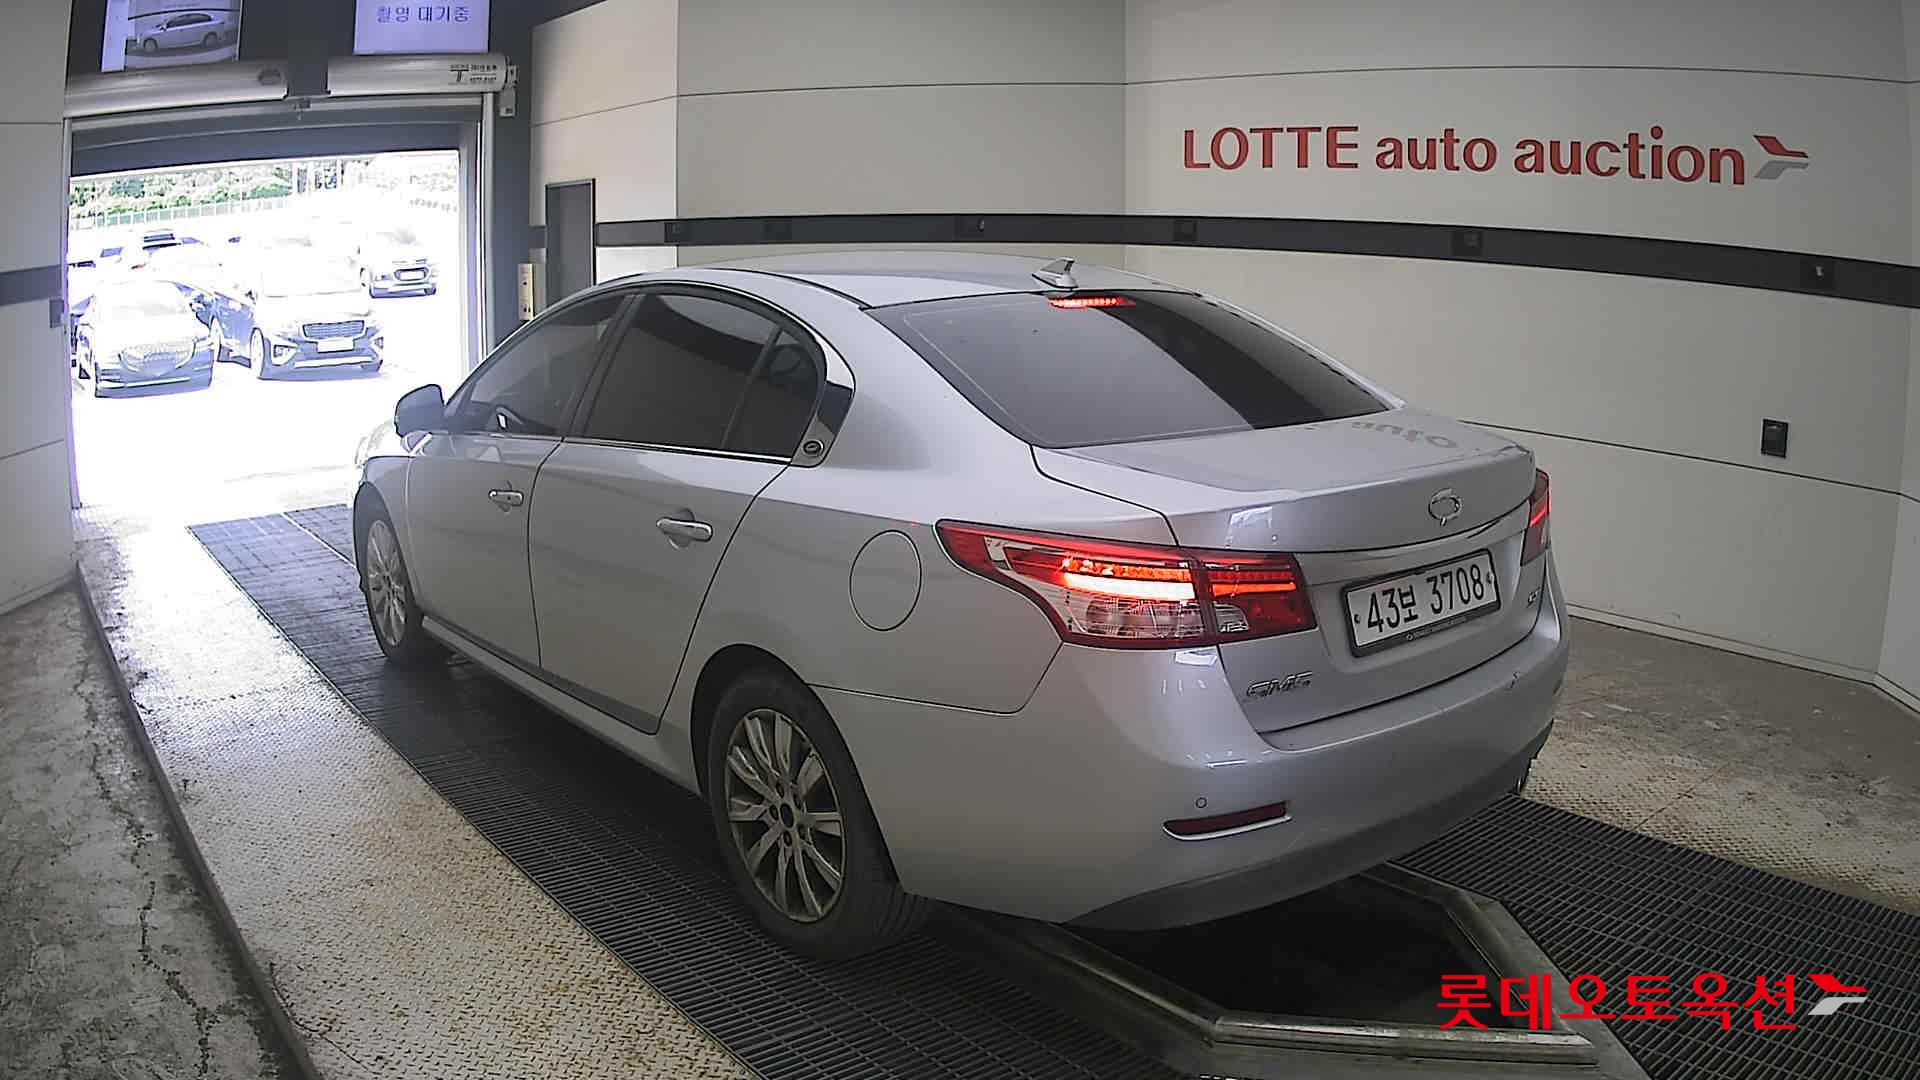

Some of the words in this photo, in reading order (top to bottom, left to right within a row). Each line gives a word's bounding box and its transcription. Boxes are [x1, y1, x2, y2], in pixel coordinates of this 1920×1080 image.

[418, 5, 469, 22] 대기중
[1184, 126, 1359, 169] LOTTE
[1376, 128, 1497, 172] auto
[1514, 126, 1745, 185] auction
[1367, 585, 1419, 632] 43보
[1427, 565, 1485, 614] 3708
